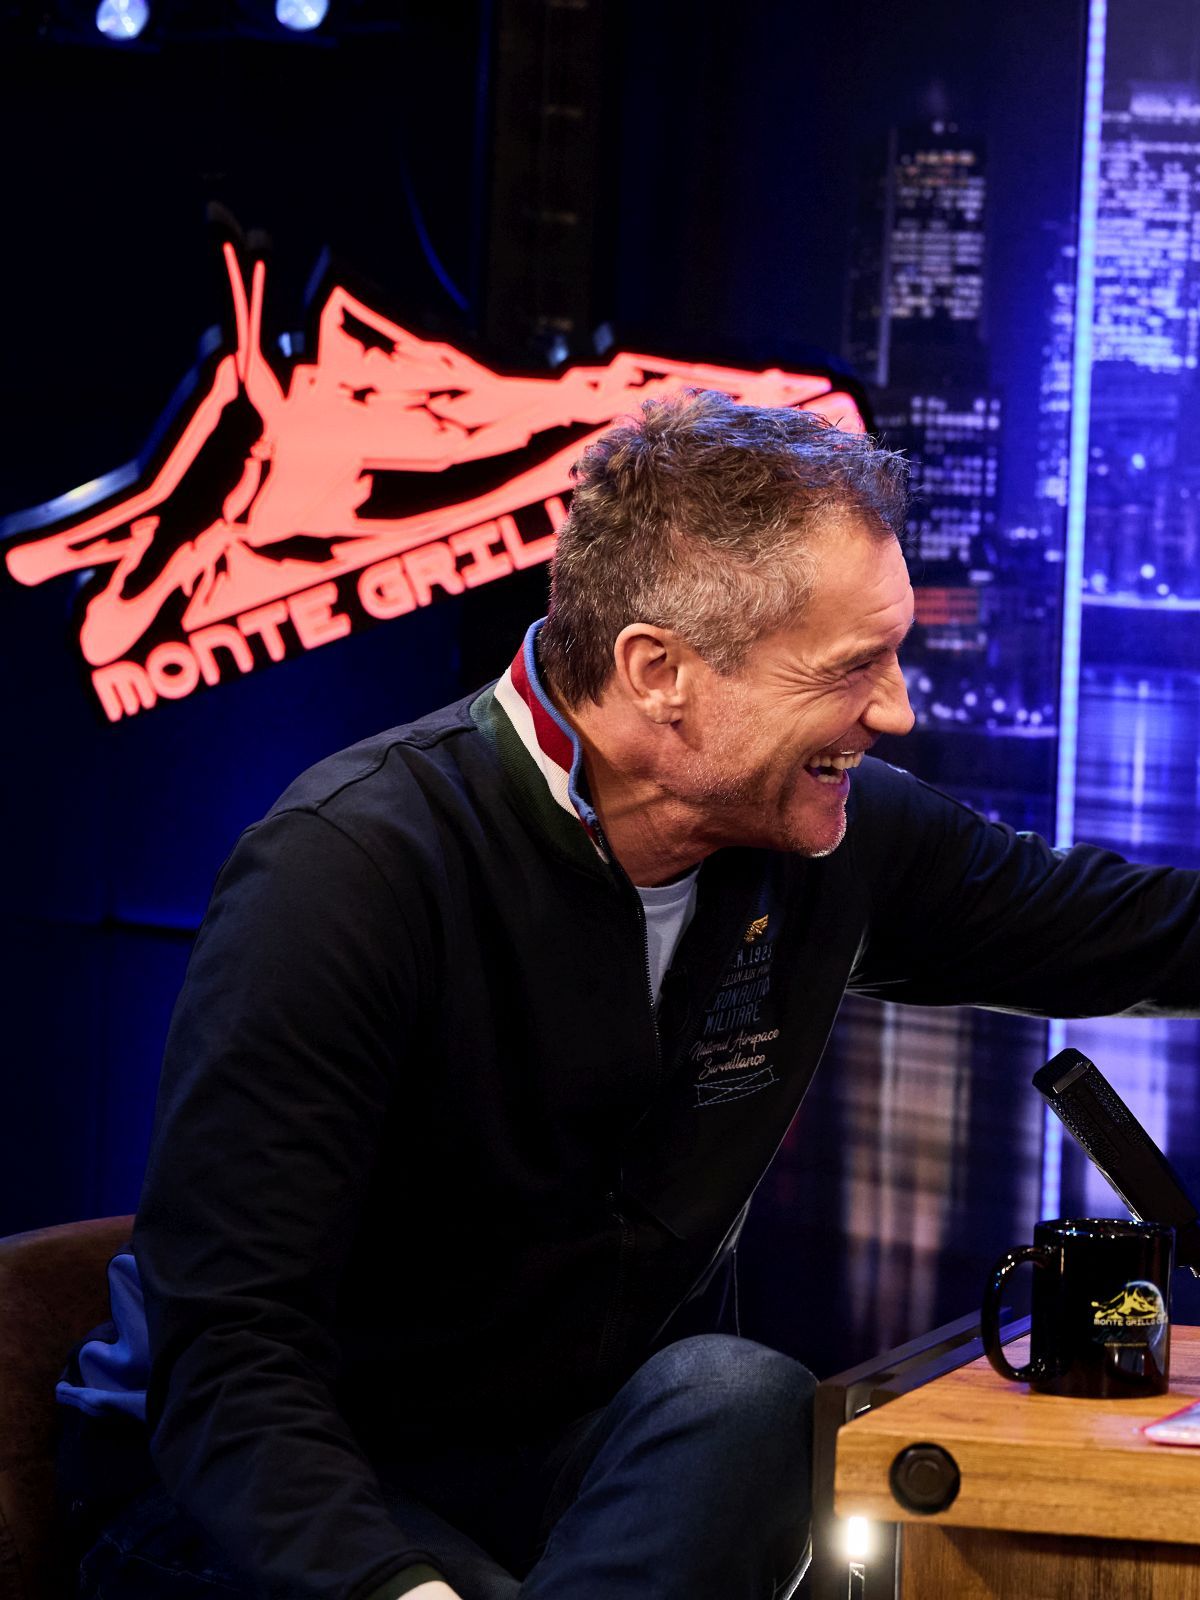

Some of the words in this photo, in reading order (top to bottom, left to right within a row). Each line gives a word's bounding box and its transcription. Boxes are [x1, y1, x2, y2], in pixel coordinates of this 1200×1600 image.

[91, 581, 352, 723] MONTE
[703, 999, 763, 1035] MILITARE
[729, 1028, 781, 1053] Airspace
[698, 1052, 767, 1080] Surveillance
